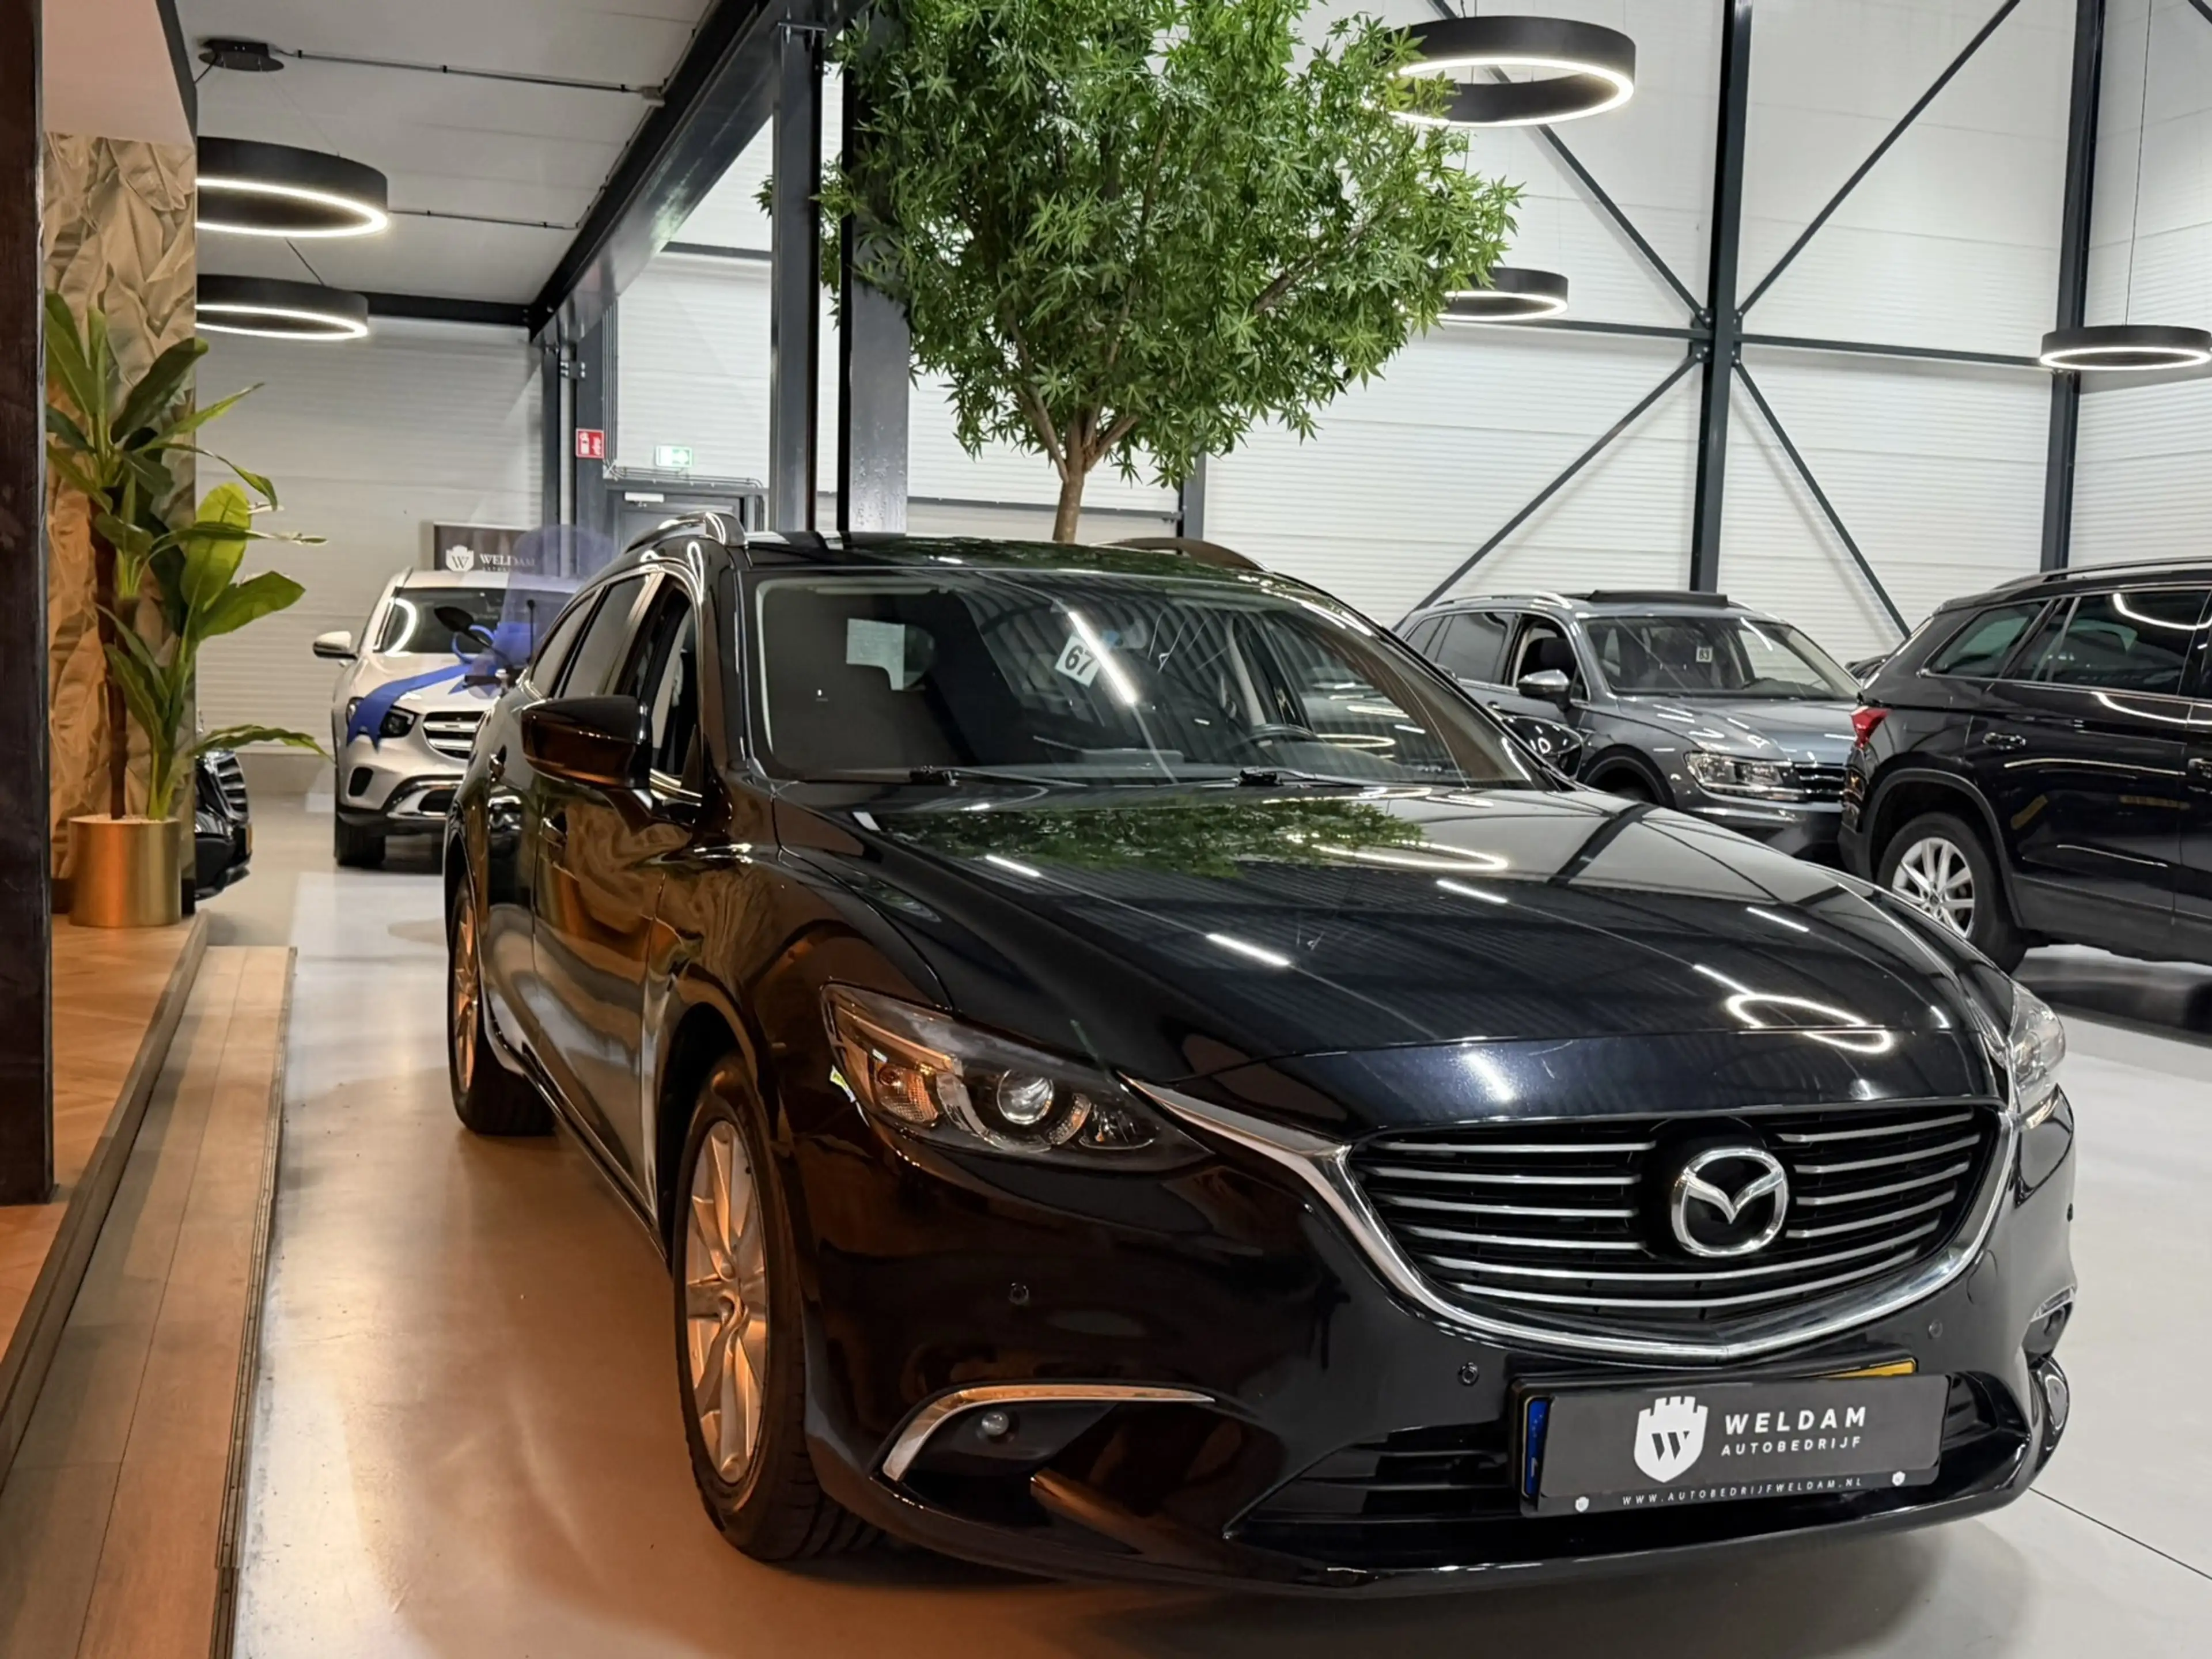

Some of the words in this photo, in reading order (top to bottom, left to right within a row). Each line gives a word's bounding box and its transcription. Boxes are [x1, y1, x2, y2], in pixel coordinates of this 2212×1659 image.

[1065, 645, 1095, 677] 67
[1725, 1406, 1866, 1435] WELDAM
[1651, 1430, 1690, 1462] W
[1721, 1435, 1861, 1457] AUTOBEDRIJF
[1622, 1478, 1862, 1506] WWW.AUTOBEDRIJFWELDAM.NL
